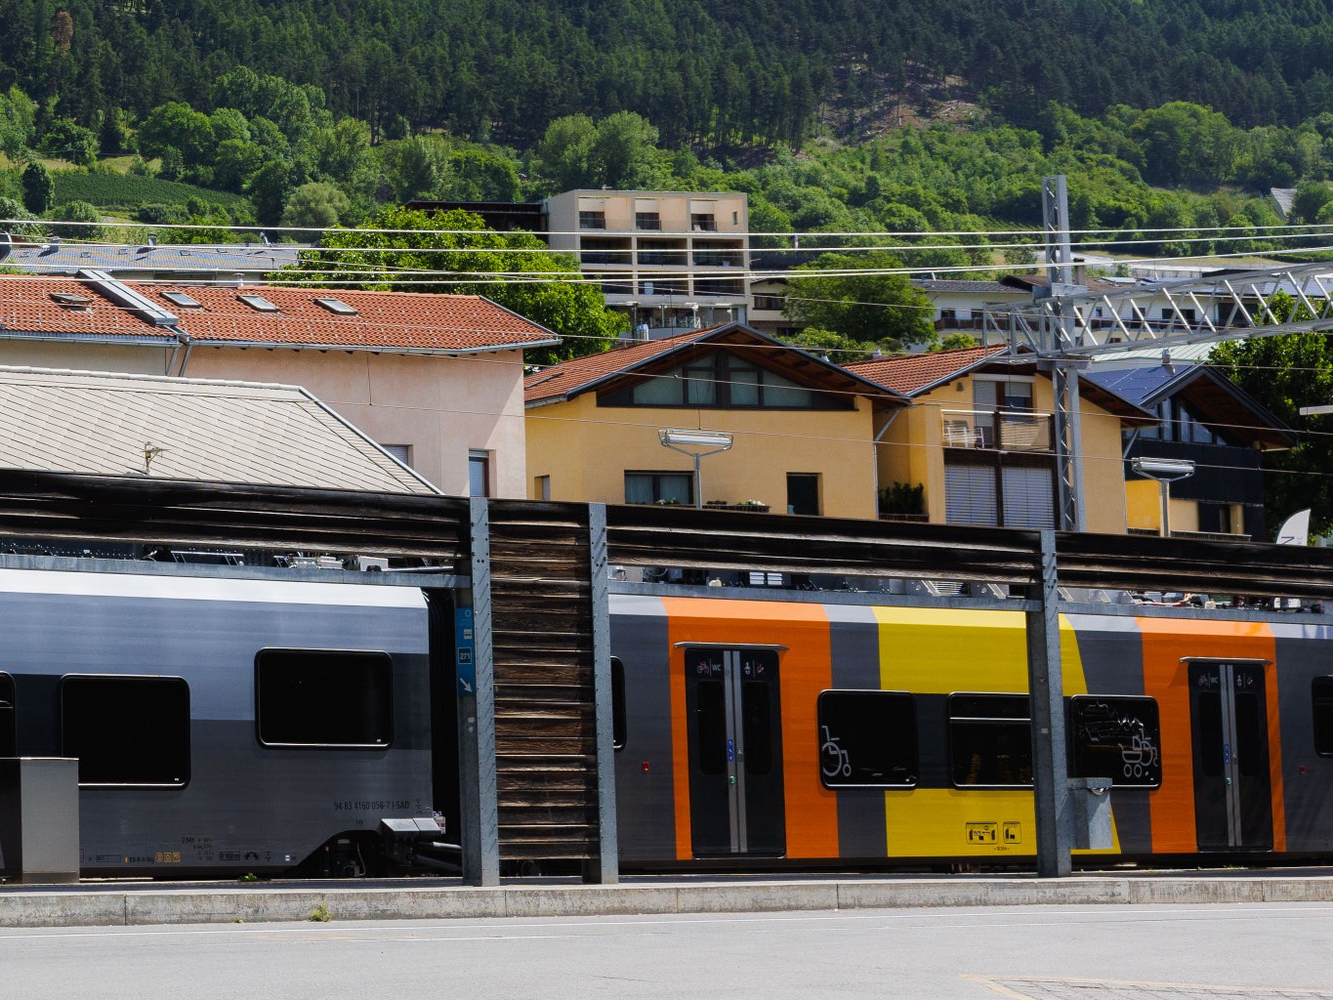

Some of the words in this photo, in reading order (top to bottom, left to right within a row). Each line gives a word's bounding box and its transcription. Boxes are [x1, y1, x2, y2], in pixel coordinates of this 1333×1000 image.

[460, 652, 470, 660] 271
[334, 802, 342, 810] 94
[355, 801, 369, 810] 4160
